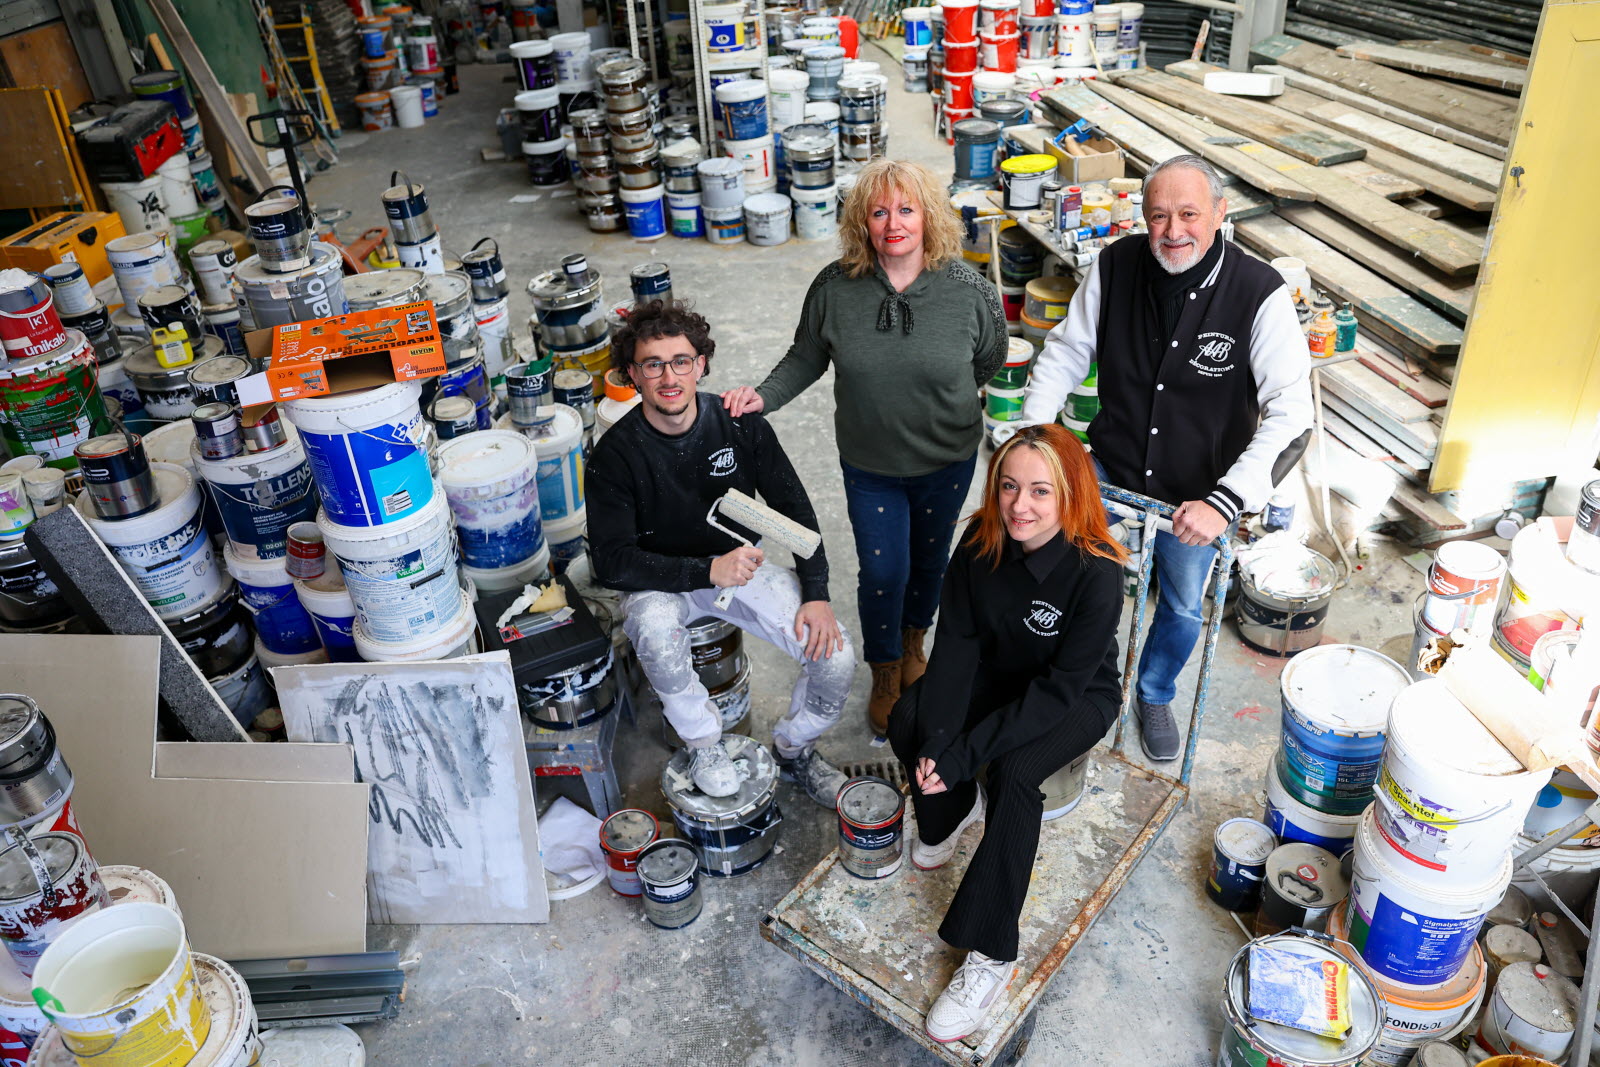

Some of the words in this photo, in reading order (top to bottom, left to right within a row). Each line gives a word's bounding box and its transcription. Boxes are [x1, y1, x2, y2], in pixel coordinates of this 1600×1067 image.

[23, 332, 66, 356] unikalo
[1197, 332, 1236, 345] PEINTURES
[343, 335, 434, 356] REVOLUTION
[410, 347, 434, 356] NUAIR
[157, 594, 185, 605] VELOURS
